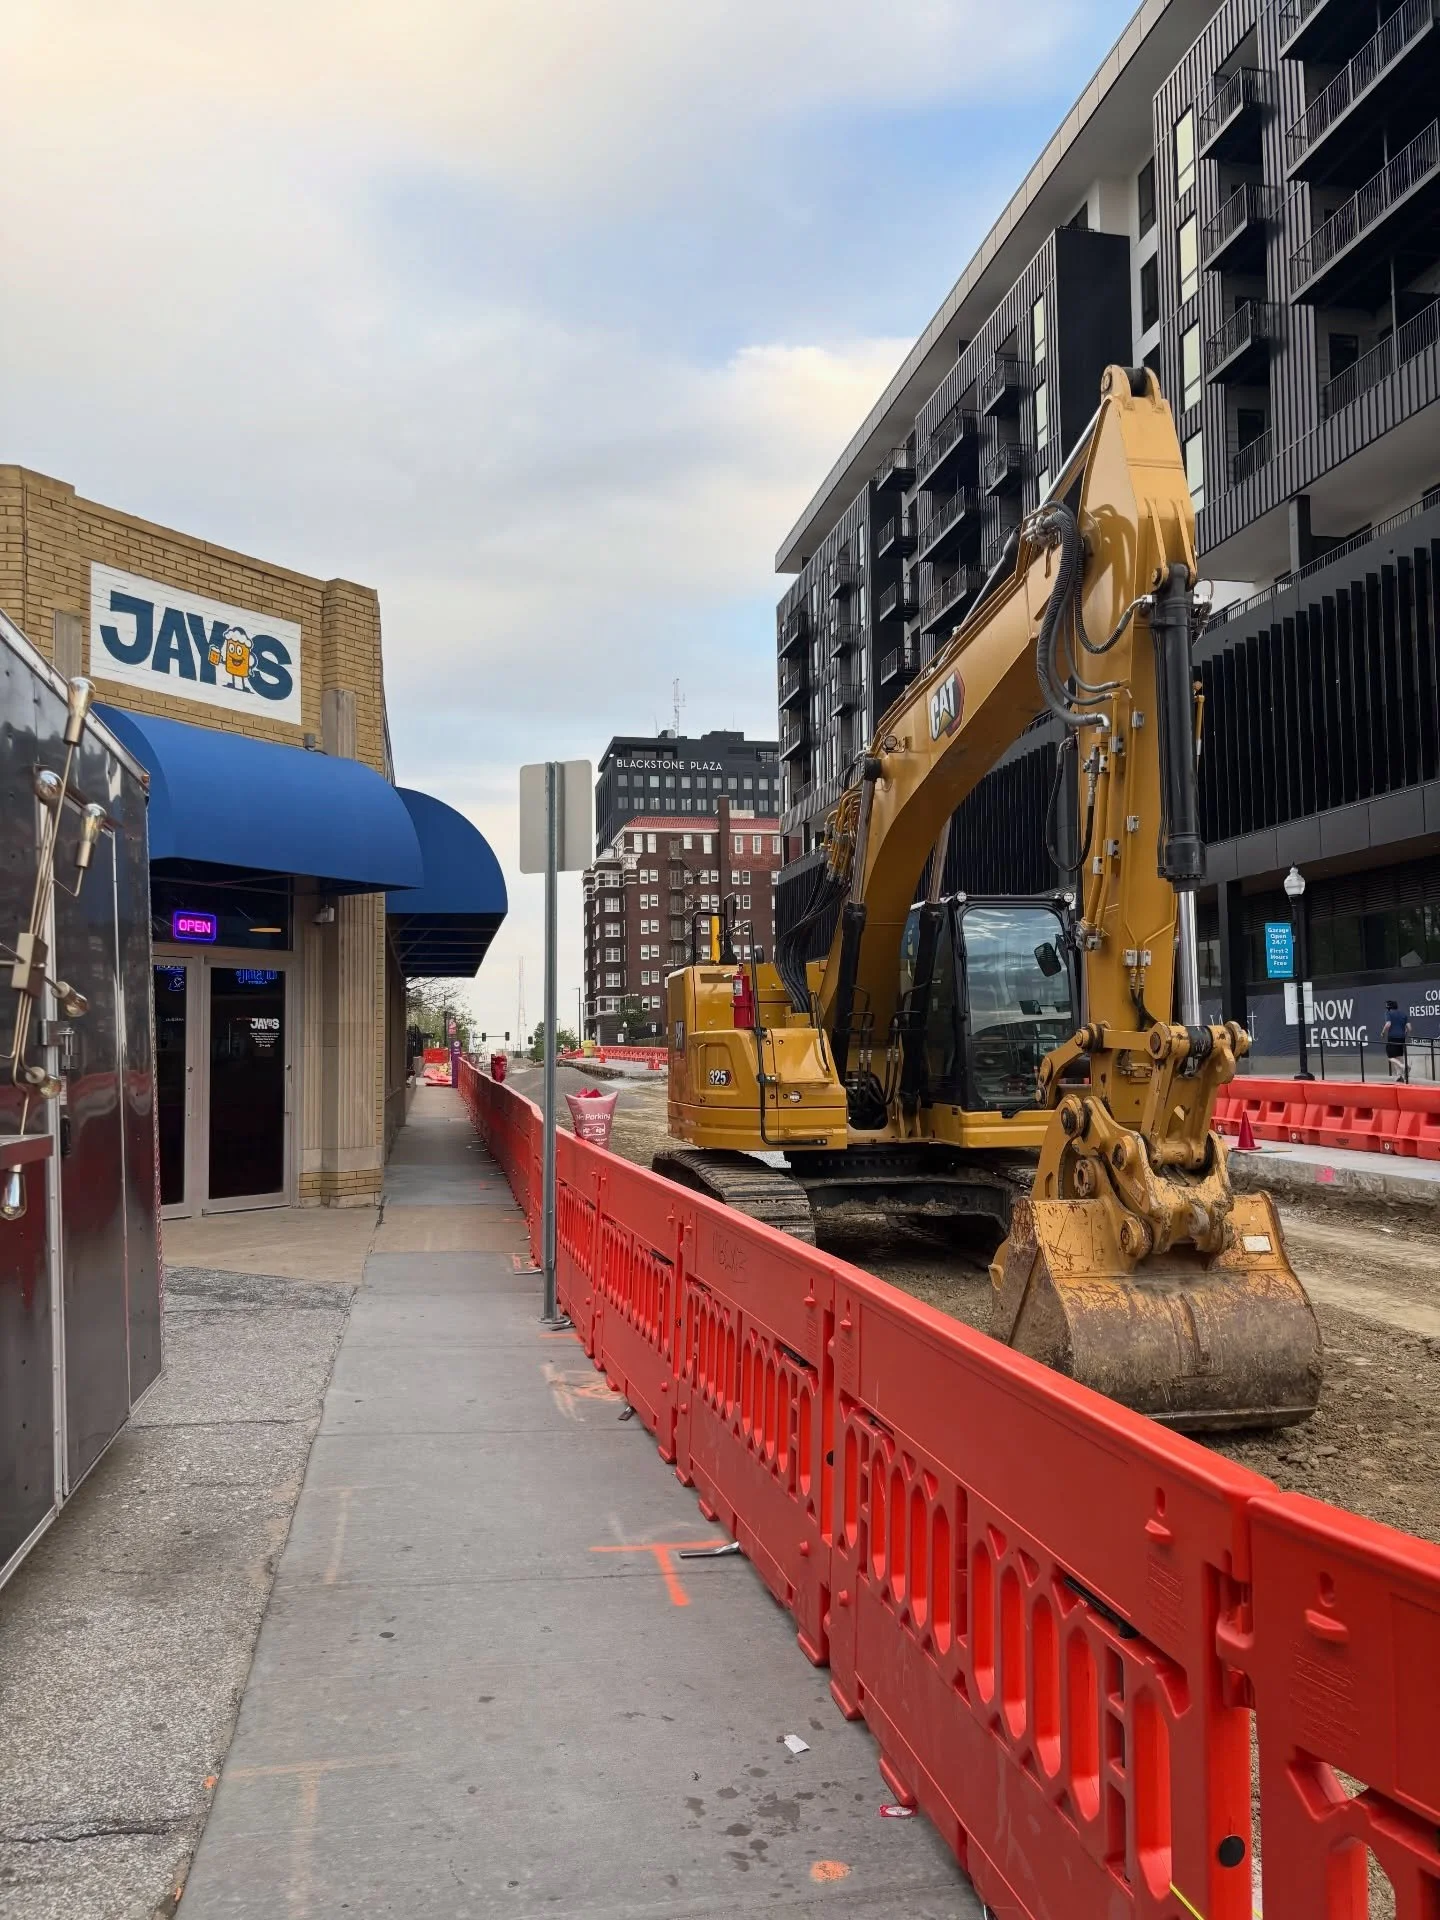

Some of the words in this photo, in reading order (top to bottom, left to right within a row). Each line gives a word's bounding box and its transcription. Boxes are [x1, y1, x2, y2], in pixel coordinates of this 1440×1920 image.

[930, 671, 955, 740] CAT
[616, 759, 685, 770] BLACKSTONE
[690, 761, 723, 771] PLAZA
[178, 919, 211, 934] OPEN
[1313, 998, 1354, 1021] NOW
[709, 1069, 727, 1086] 325
[585, 1112, 611, 1121] Parking
